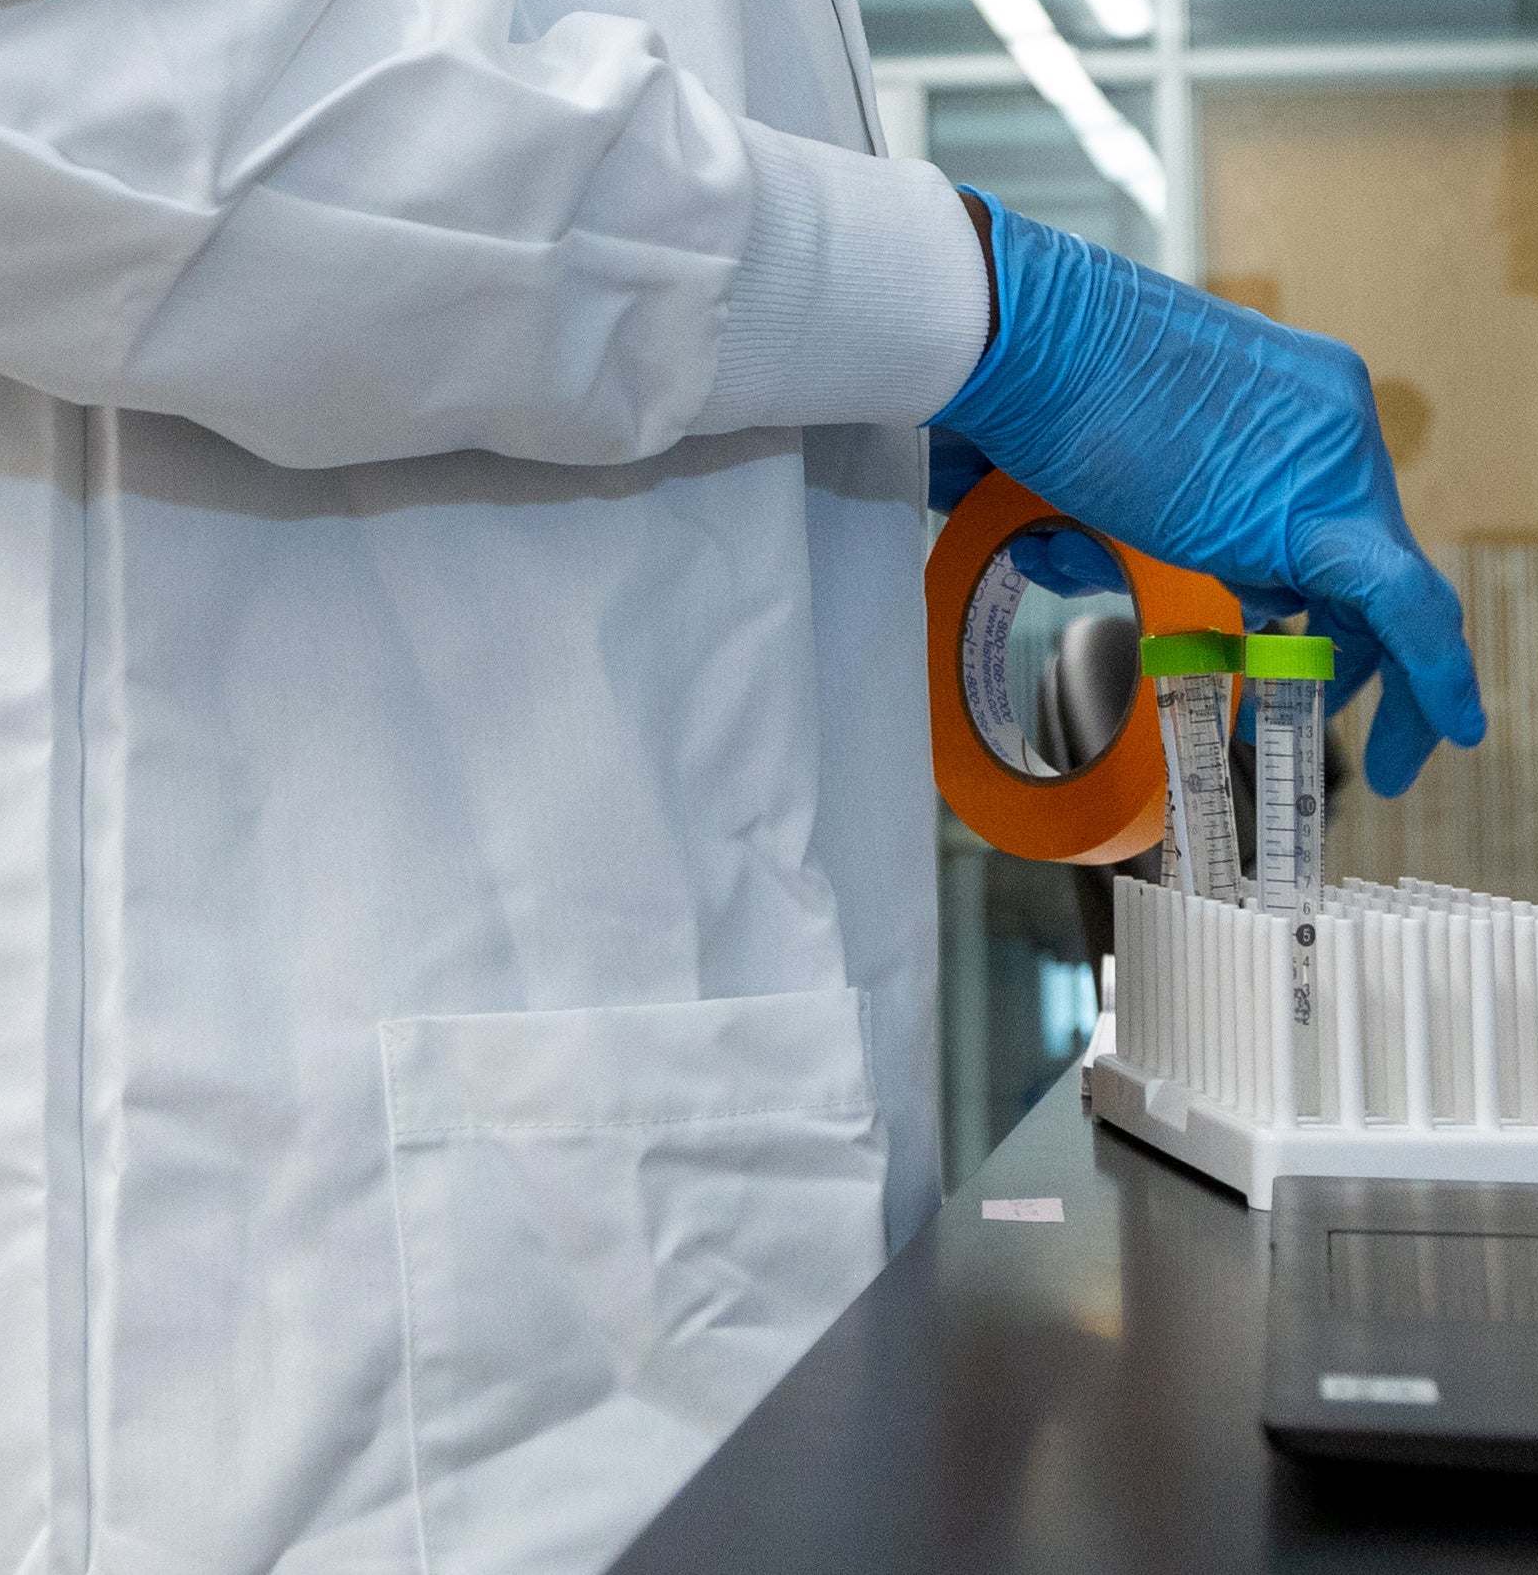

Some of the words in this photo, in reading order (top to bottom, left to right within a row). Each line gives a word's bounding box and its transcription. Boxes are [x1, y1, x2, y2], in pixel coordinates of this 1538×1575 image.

[1303, 875, 1311, 888] 7
[1303, 902, 1311, 915] 6
[1302, 956, 1310, 968] 4
